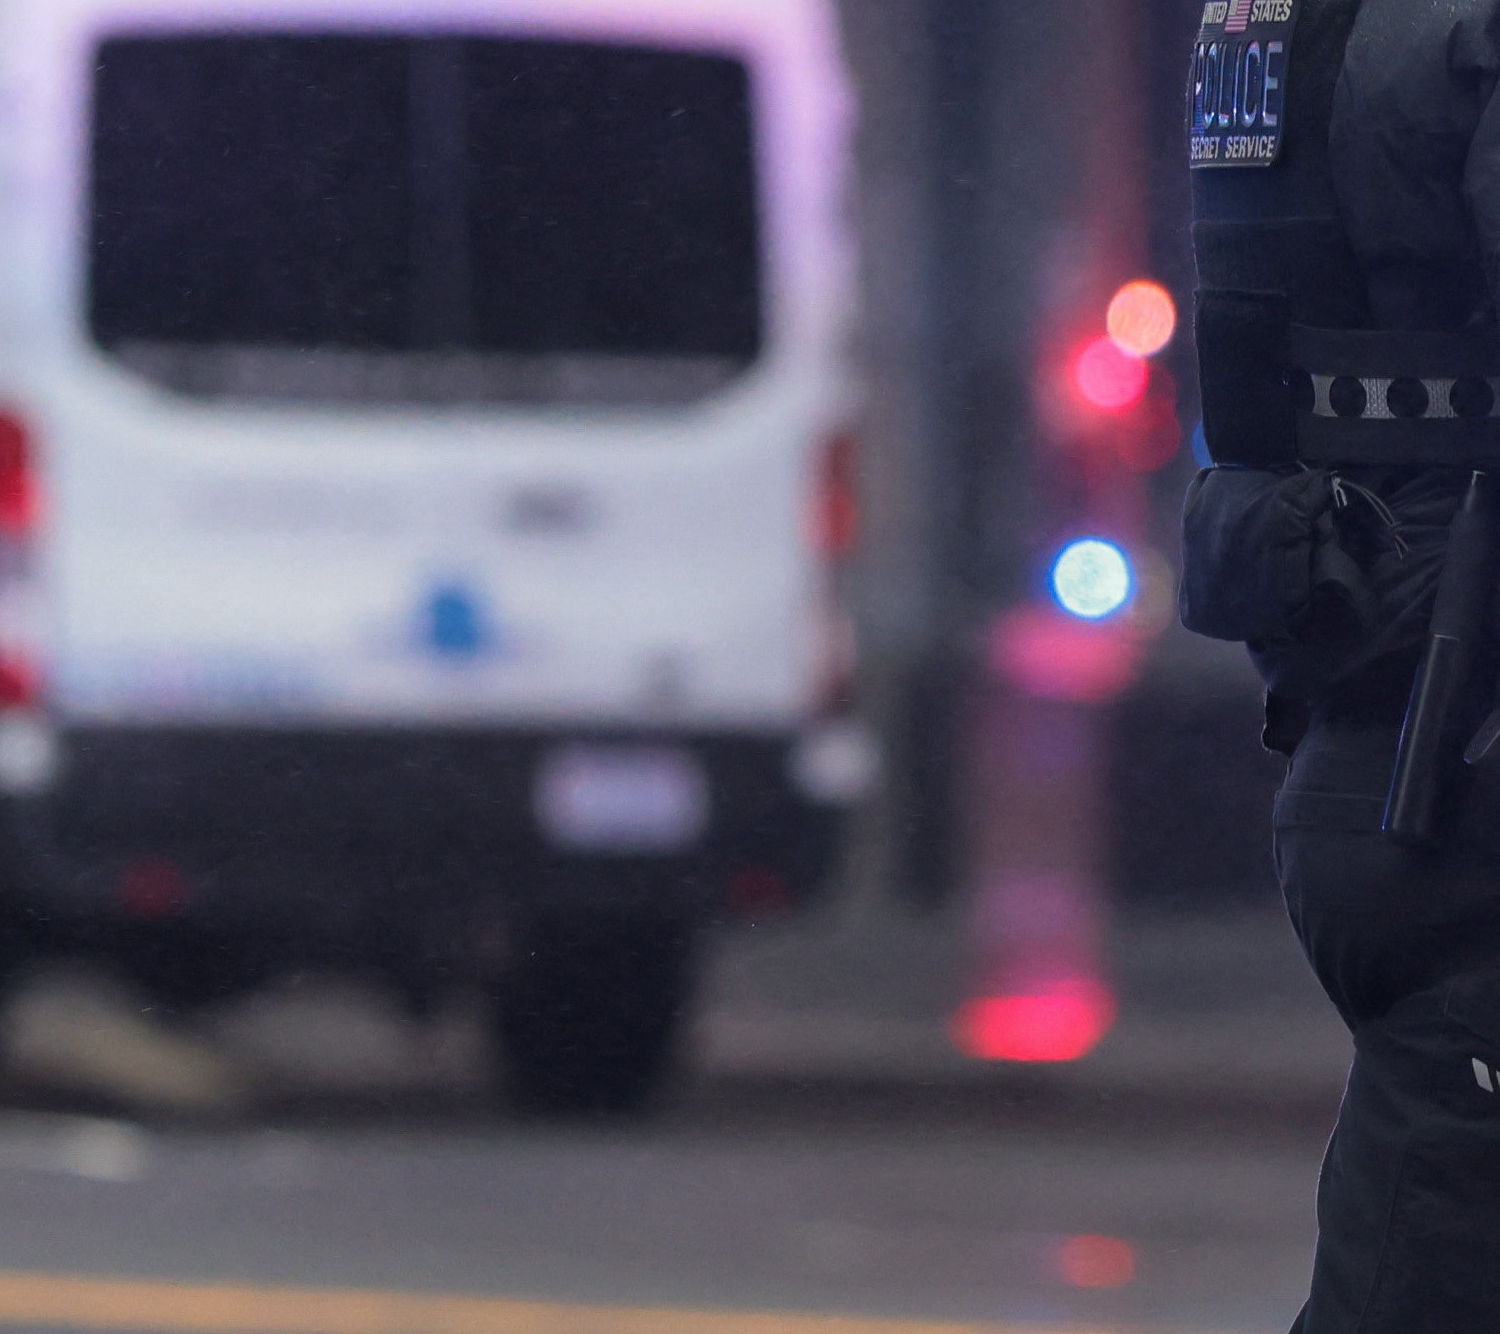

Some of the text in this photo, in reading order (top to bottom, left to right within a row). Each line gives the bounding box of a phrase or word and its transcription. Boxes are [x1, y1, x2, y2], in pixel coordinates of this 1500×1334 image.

[1203, 1, 1228, 24] UNITED
[1193, 40, 1284, 129] POLICE
[1191, 134, 1276, 160] SECRET SERVICE
